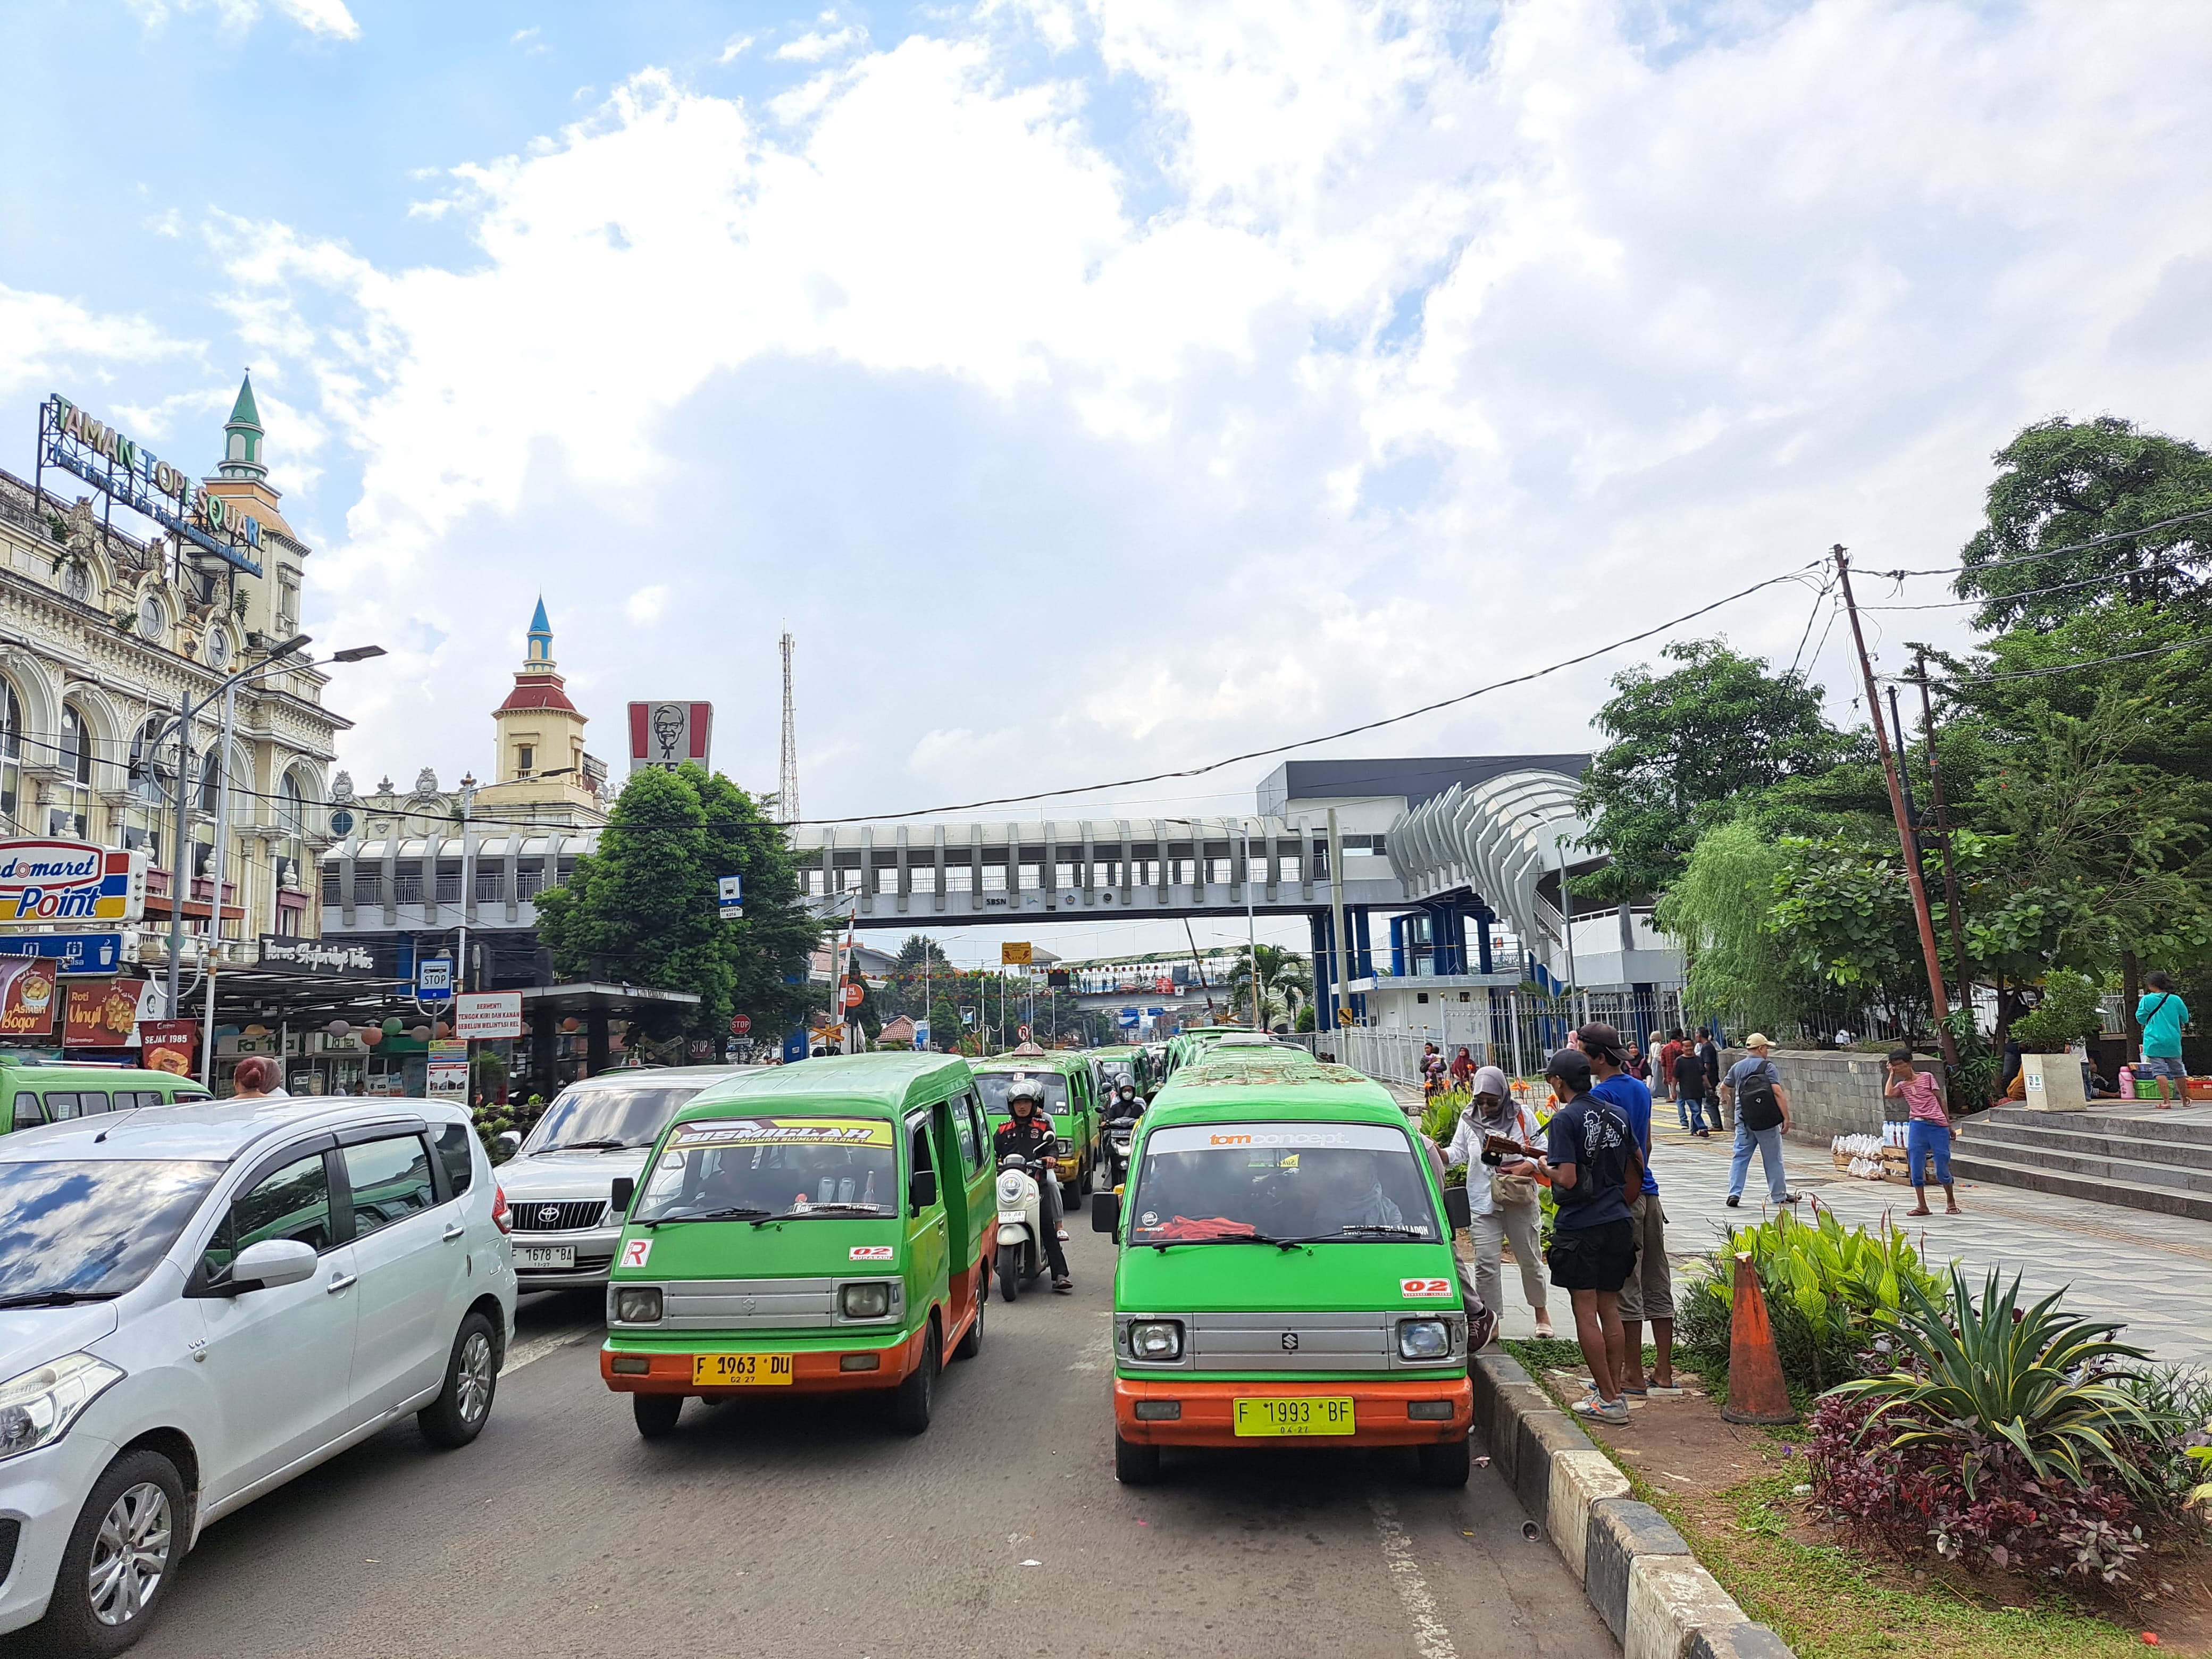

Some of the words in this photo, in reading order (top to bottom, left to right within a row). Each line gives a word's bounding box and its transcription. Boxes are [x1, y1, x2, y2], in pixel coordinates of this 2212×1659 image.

[51, 393, 136, 472] TAMAN
[140, 449, 189, 506] TOPI
[195, 485, 266, 552] SQUARE
[0, 855, 95, 878] domaret
[14, 886, 101, 918] Point
[424, 975, 446, 985] STOP
[72, 992, 89, 1001] Roti
[13, 1003, 46, 1014] Asinan
[2, 1010, 39, 1033] Bogor
[69, 1004, 103, 1029] Unyil
[145, 1035, 167, 1044] SEJAK
[169, 1034, 188, 1043] 1985
[692, 1040, 708, 1052] STOP
[677, 1128, 874, 1143] BISMILLAH
[527, 1248, 551, 1261] 1678
[560, 1248, 572, 1260] BA
[1404, 1280, 1448, 1292] 02
[697, 1357, 706, 1374] F
[717, 1356, 756, 1374] 1963
[770, 1356, 790, 1373] DU
[1239, 1402, 1248, 1423] F
[1269, 1402, 1309, 1422] 1993
[1328, 1401, 1349, 1422] BF
